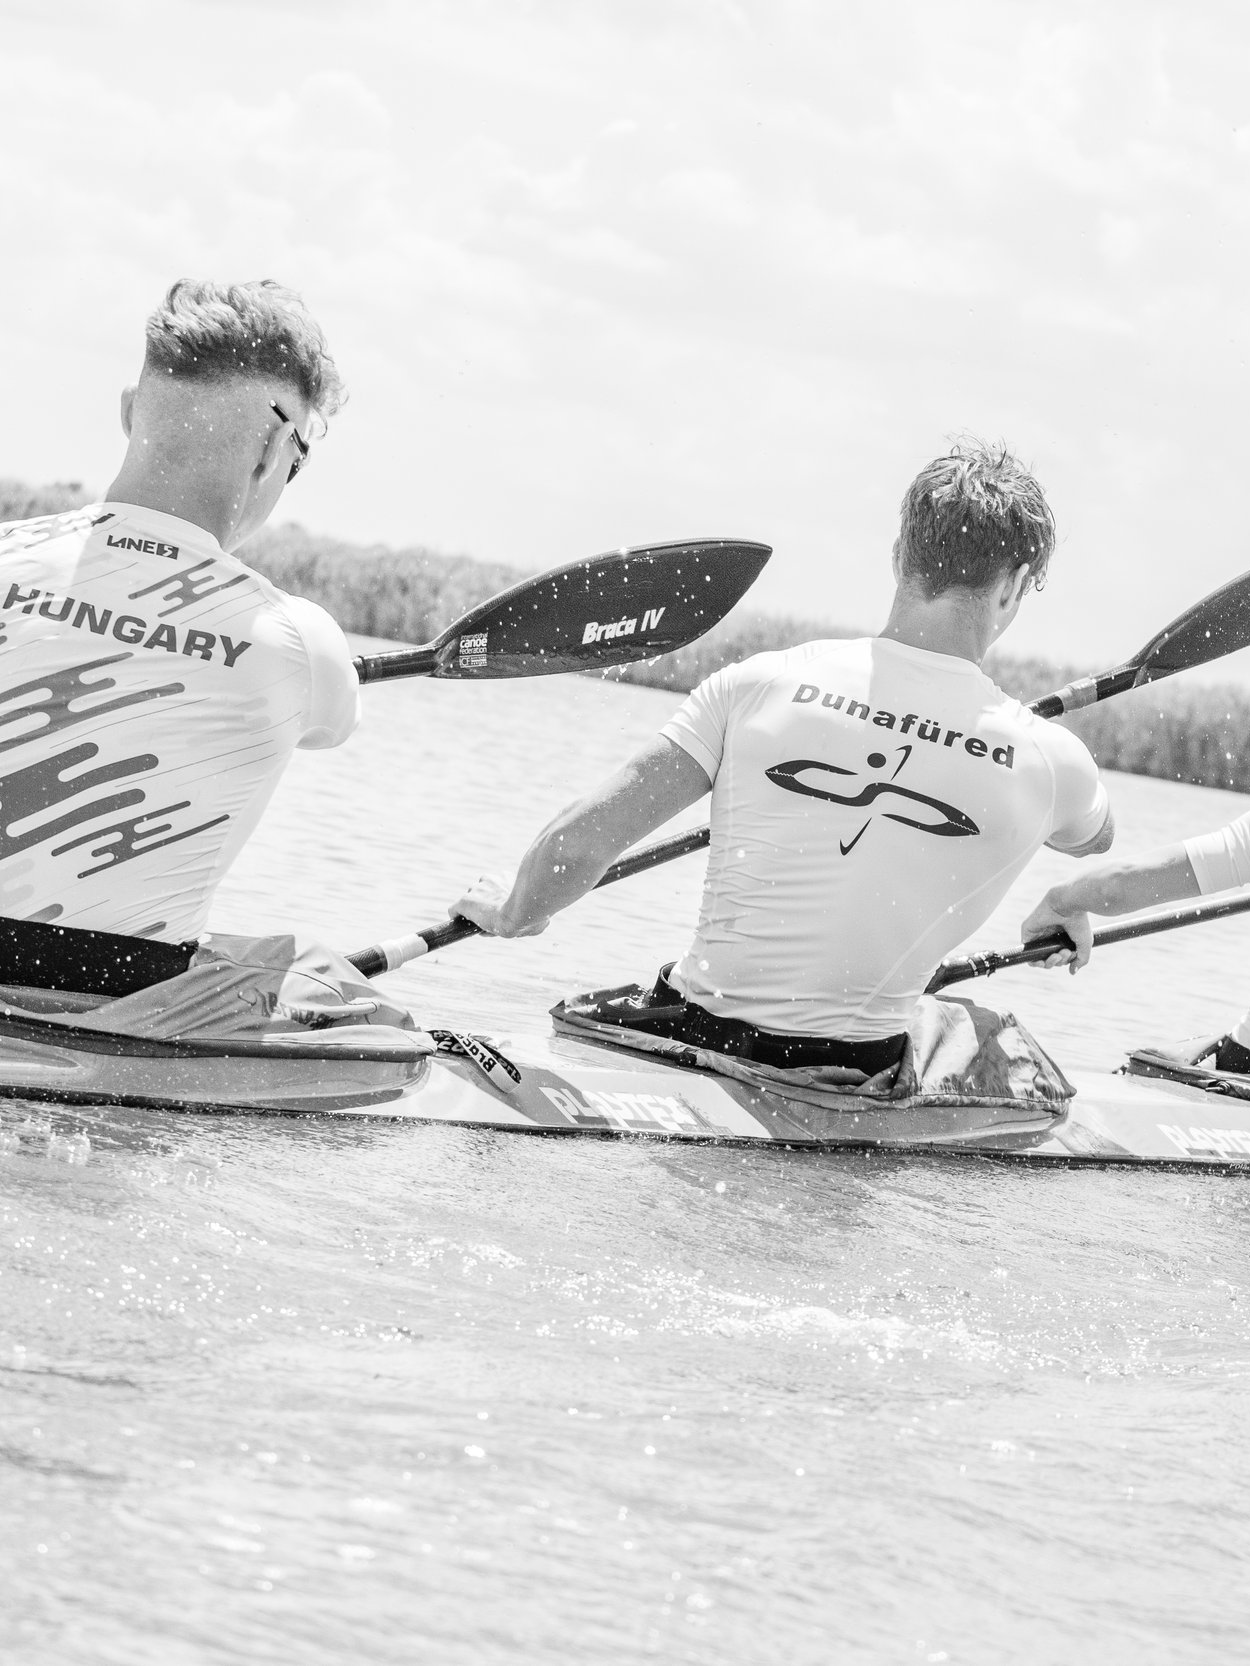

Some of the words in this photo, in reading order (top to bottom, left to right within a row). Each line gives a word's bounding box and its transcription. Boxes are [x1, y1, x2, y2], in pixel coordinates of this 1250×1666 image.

[2, 583, 252, 668] HUNGARY
[460, 638, 488, 649] canoe
[640, 606, 667, 632] IV
[791, 683, 1016, 769] Dunafüred
